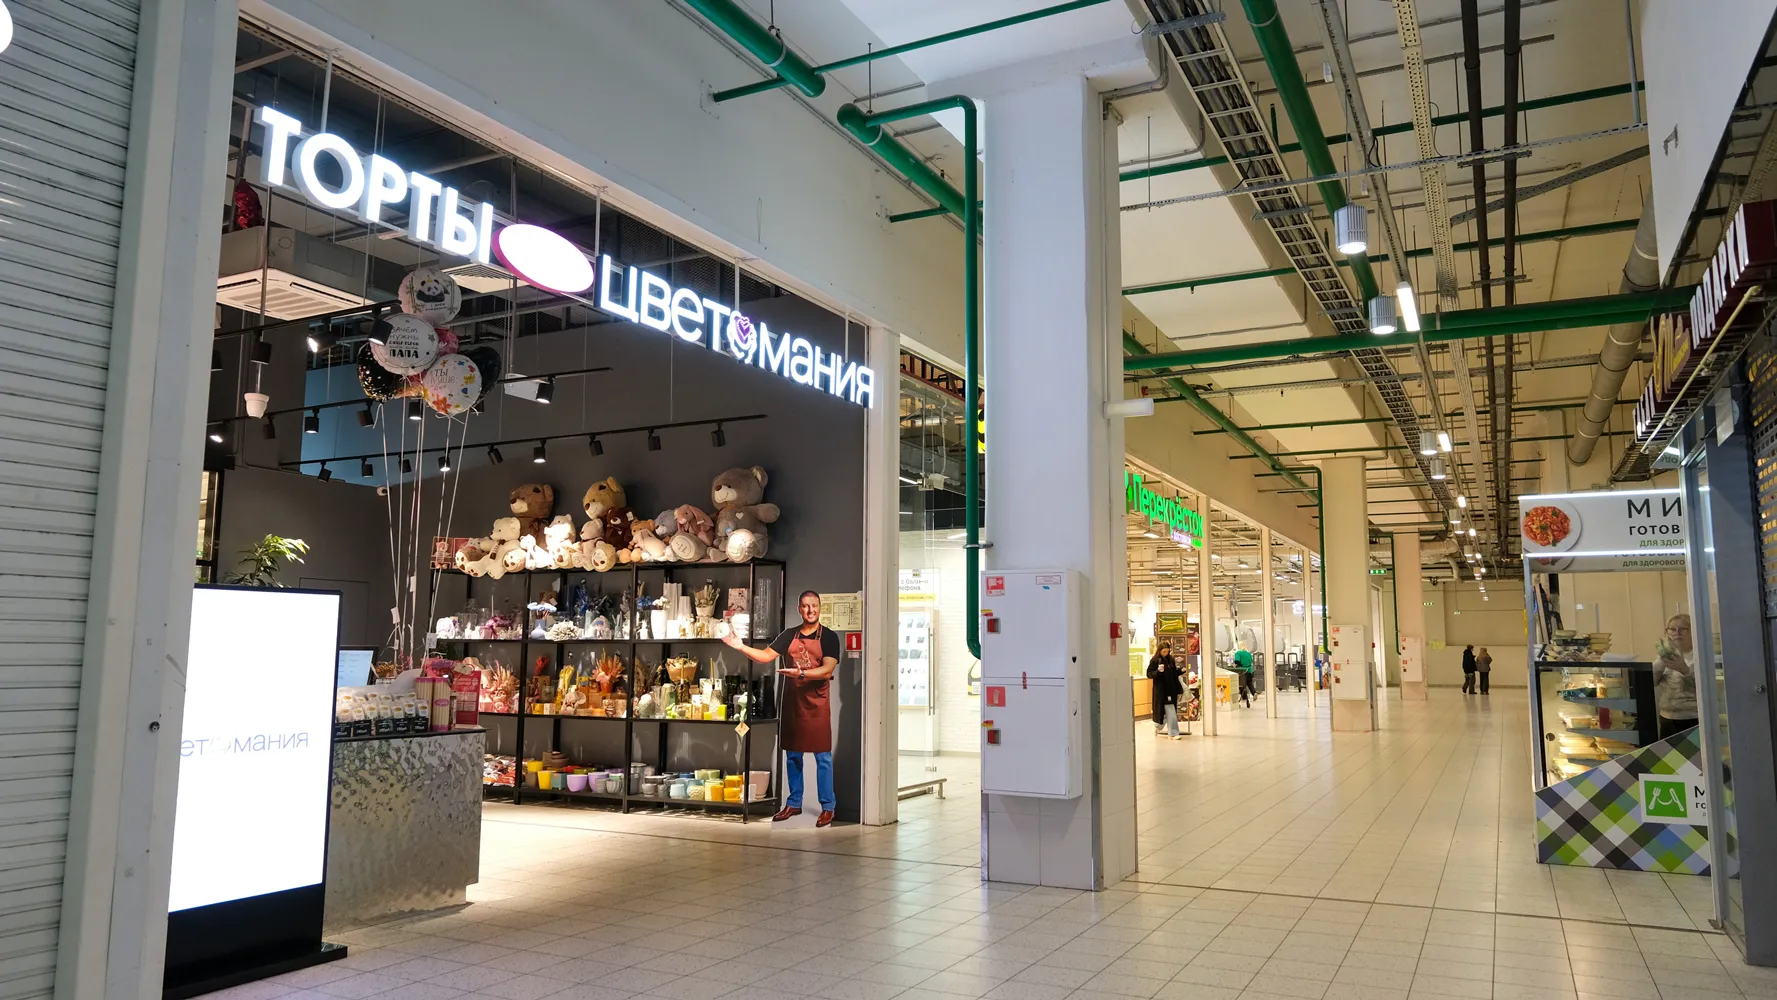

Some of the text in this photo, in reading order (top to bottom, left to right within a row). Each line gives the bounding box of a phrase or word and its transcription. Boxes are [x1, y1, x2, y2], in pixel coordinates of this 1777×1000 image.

[256, 105, 494, 265] ТОРТЫ
[1689, 203, 1750, 349] ПОДАРКИ
[389, 349, 419, 359] ПАПА
[1133, 473, 1205, 539] Перекрёсток
